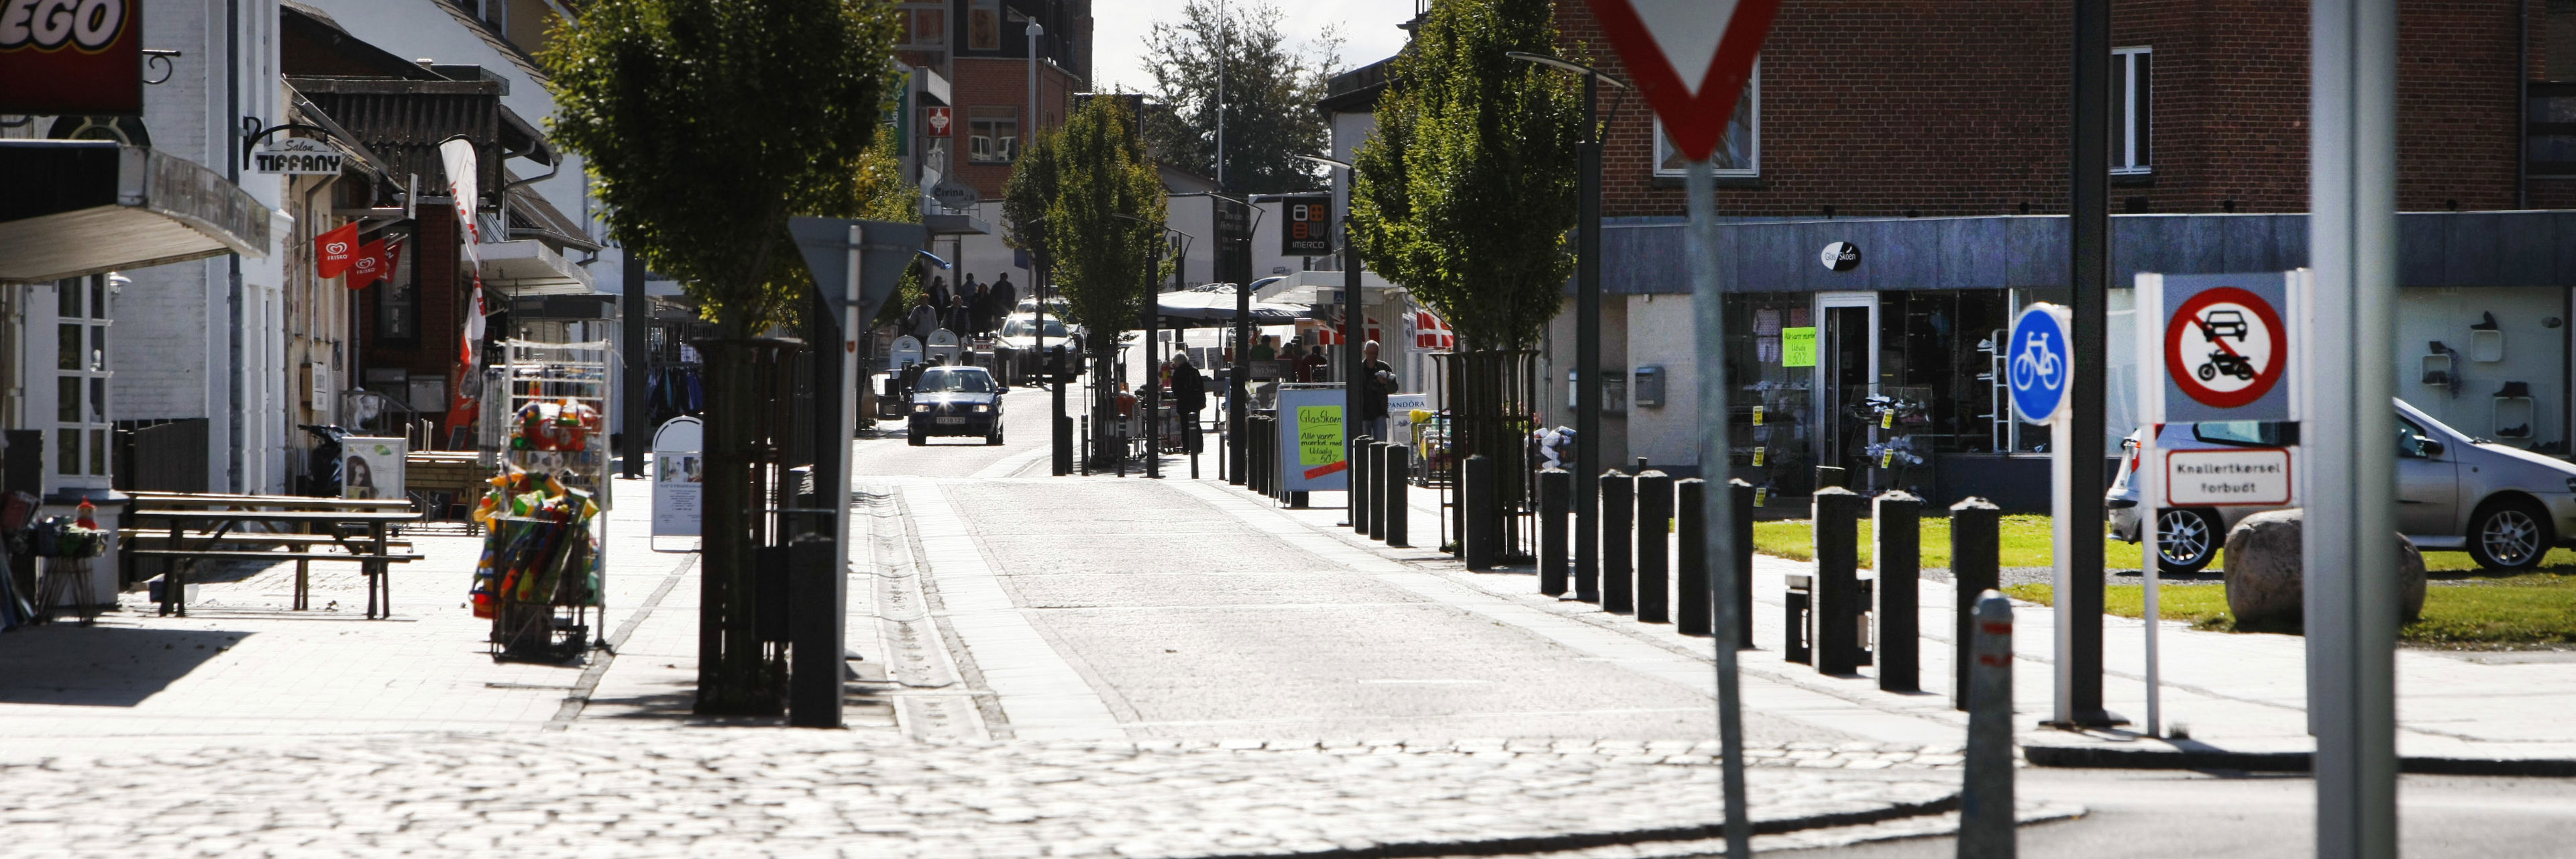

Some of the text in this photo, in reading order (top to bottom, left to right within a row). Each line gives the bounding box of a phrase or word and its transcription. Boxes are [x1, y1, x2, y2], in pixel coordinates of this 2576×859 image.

[284, 140, 314, 152] Salon
[256, 154, 341, 172] TIFFANY
[1292, 241, 1325, 249] IMERCO
[1825, 252, 1856, 261] Glas Skoen
[1309, 447, 1333, 455] Udsalg
[2201, 483, 2257, 493] forbudt
